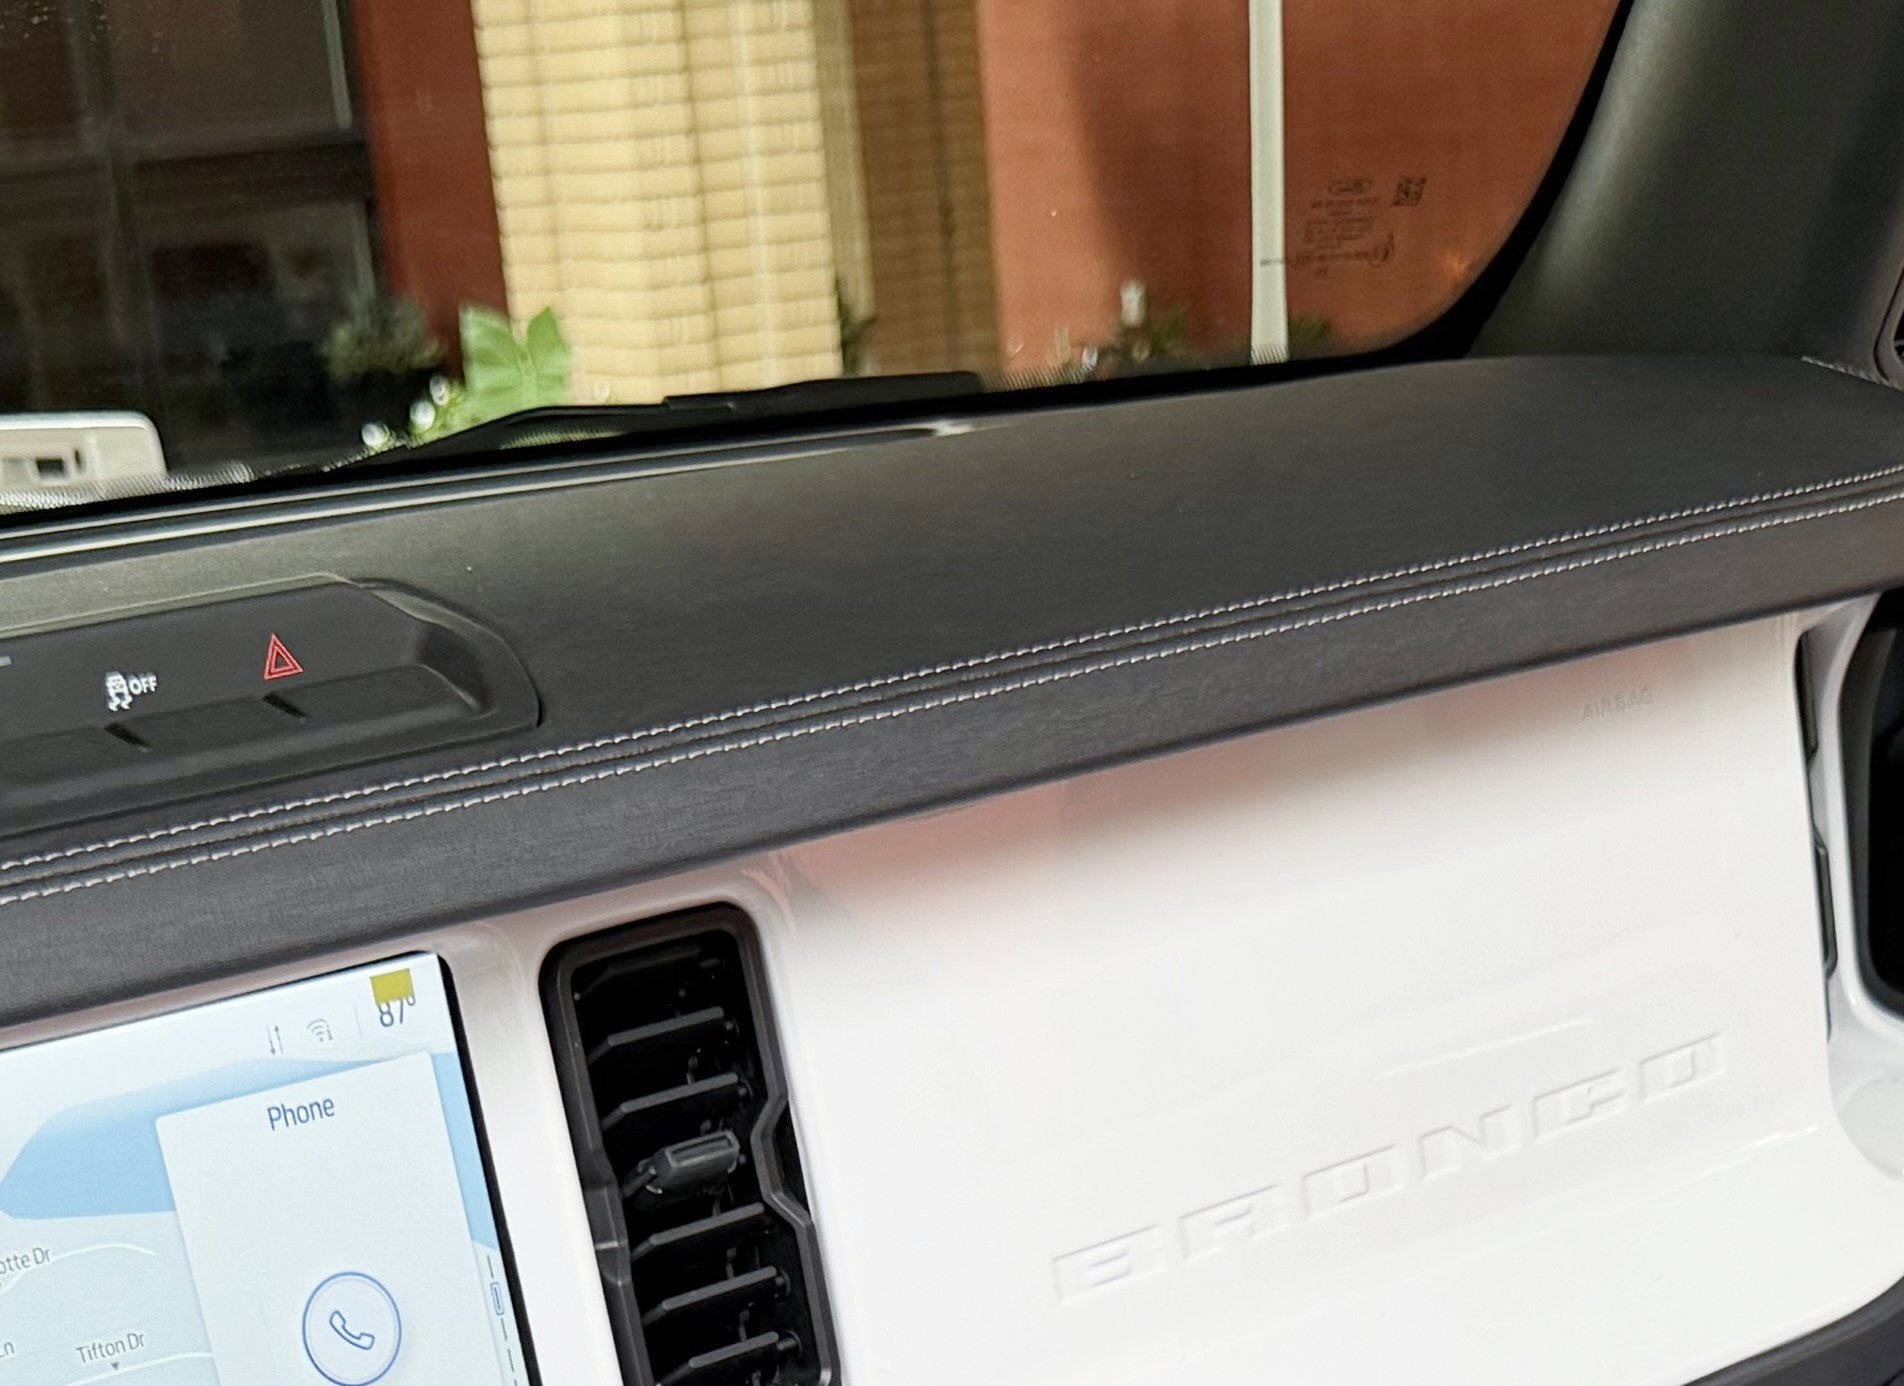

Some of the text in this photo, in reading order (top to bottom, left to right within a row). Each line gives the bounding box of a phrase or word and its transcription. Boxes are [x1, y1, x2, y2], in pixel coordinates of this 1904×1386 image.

[128, 675, 158, 695] OFF
[267, 1098, 335, 1131] Phone
[1050, 1031, 1730, 1303] BRONCO
[33, 1246, 52, 1265] Dr
[75, 1331, 146, 1365] Tifton Dr
